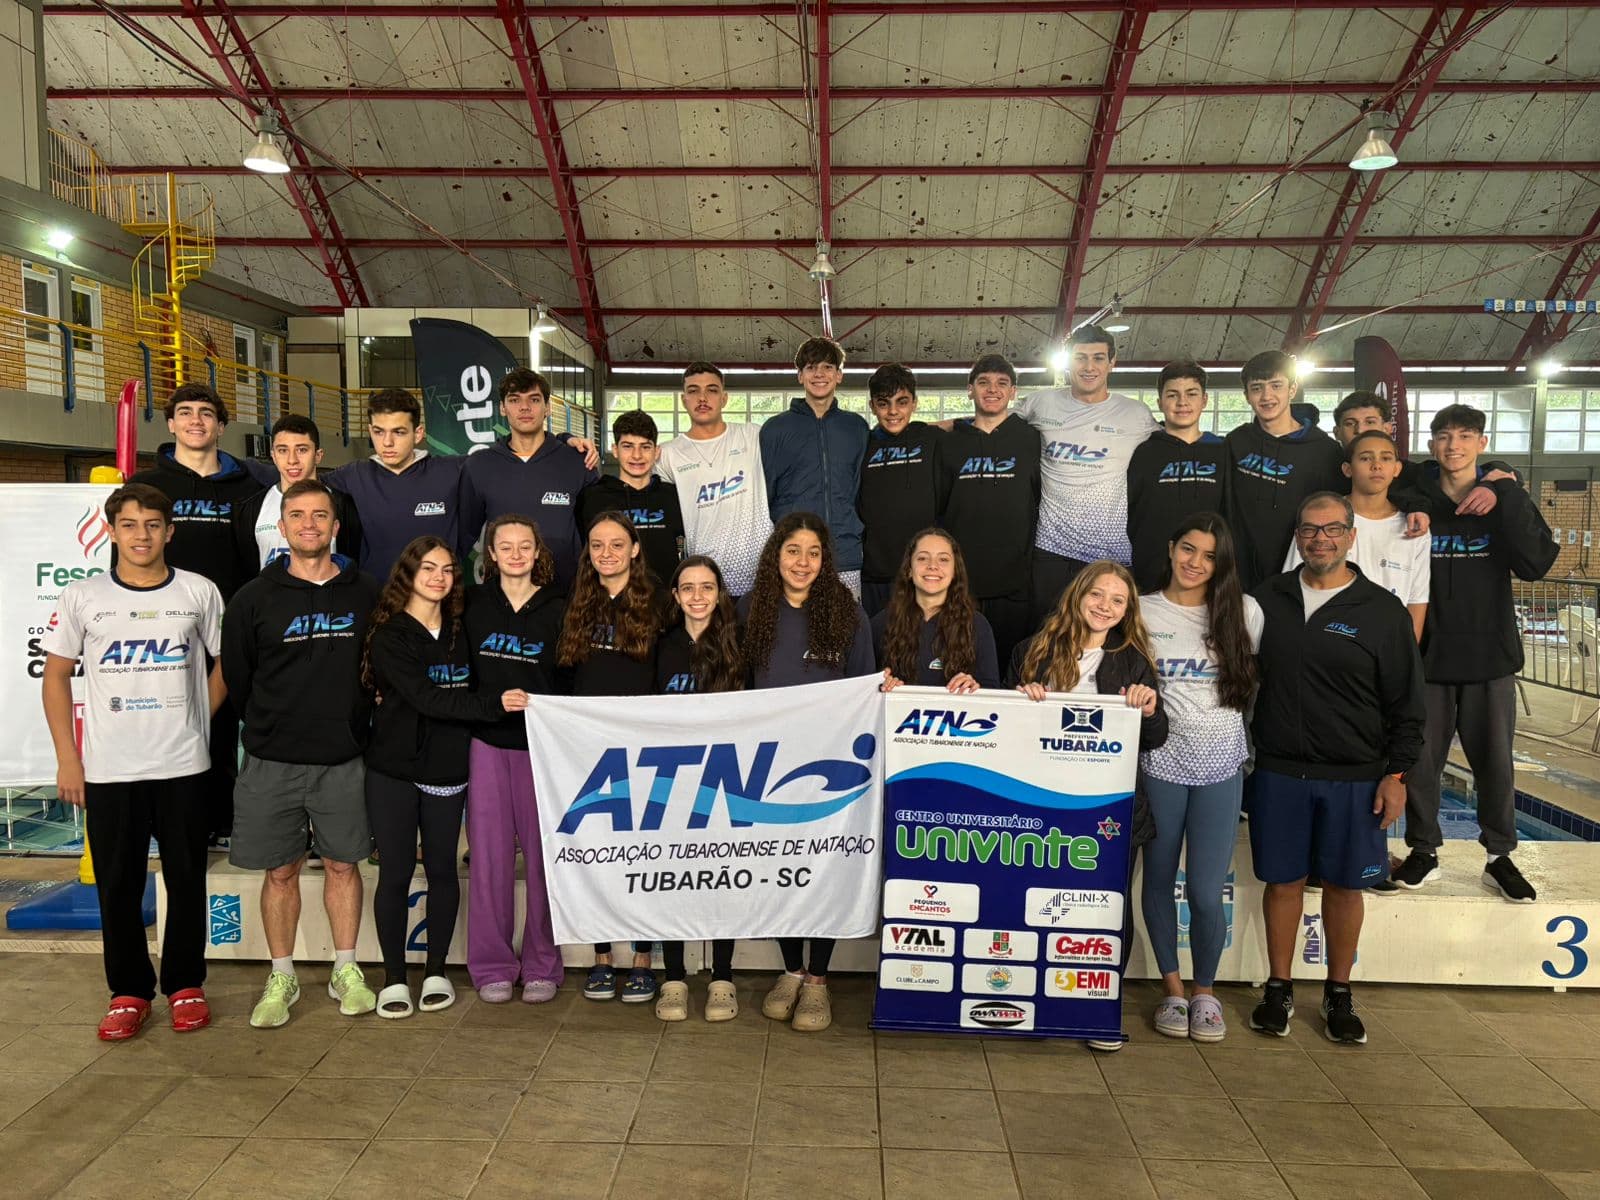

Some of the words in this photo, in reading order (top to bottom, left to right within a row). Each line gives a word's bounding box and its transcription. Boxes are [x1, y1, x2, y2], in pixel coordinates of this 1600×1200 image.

[959, 456, 995, 473] ATN
[283, 612, 331, 637] ATN
[99, 638, 171, 665] ATN
[894, 709, 968, 737] ATN
[893, 737, 928, 745] ASSOCIAÇÃO
[1039, 738, 1123, 754] TUBARÃO
[555, 741, 779, 835] ATN
[895, 809, 943, 824] CENTRO
[945, 812, 1044, 830] UNIVERSITÁRIO
[555, 841, 662, 866] ASSOCIAÇÃO
[668, 840, 779, 860] TUBARONENSE
[782, 838, 804, 855] DE
[808, 834, 876, 857] NATAÇÃO
[625, 865, 752, 894] TUBARÃO
[776, 866, 812, 888] SC
[913, 899, 947, 907] PEQUENOS
[1062, 892, 1110, 903] CLINI-X
[908, 904, 952, 914] ENCANTOS
[894, 944, 946, 954] academia
[1056, 935, 1113, 956] Caffs
[1541, 915, 1589, 979] 3
[1087, 989, 1110, 997] visual
